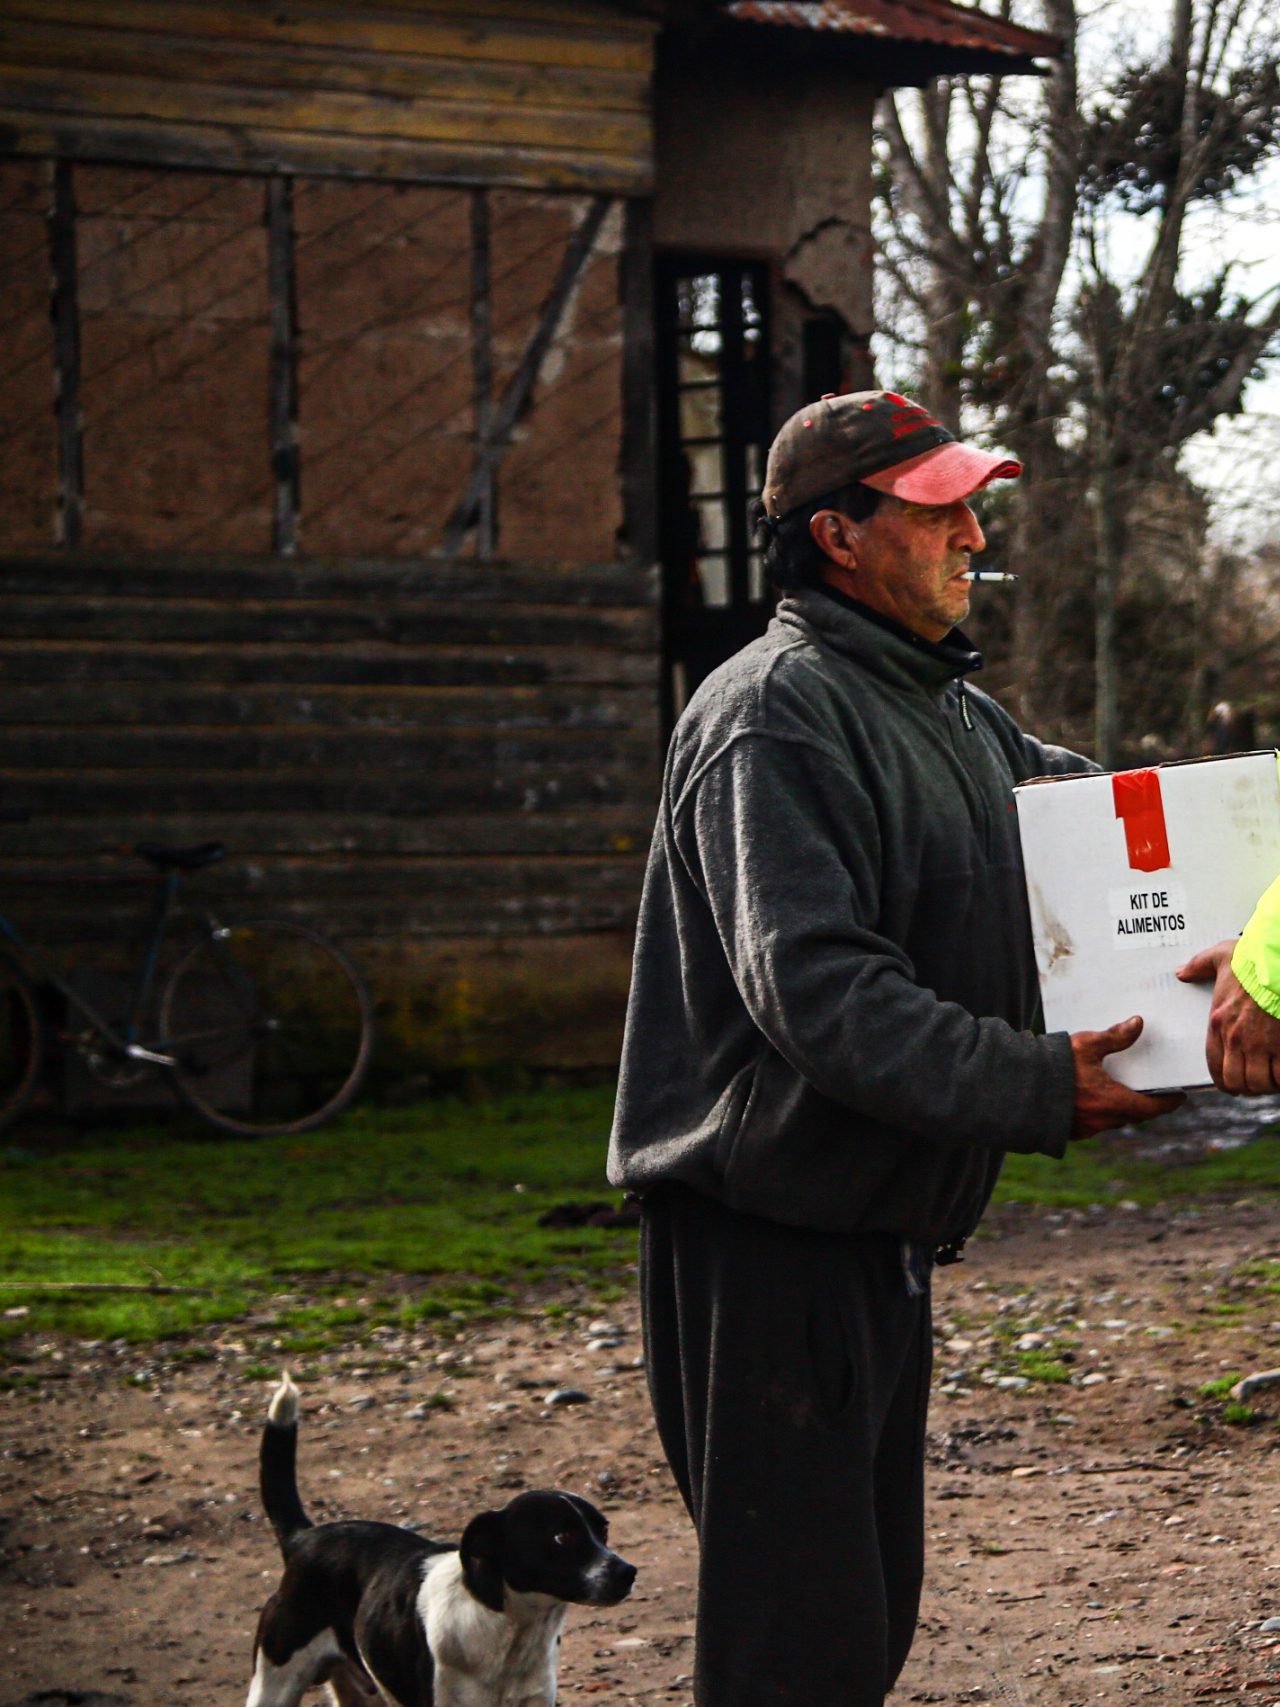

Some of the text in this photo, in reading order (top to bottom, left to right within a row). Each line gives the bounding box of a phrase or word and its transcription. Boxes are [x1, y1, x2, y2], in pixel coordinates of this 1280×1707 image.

[1130, 892, 1168, 910] KIT DE
[1118, 914, 1185, 935] ALIMENTOS
